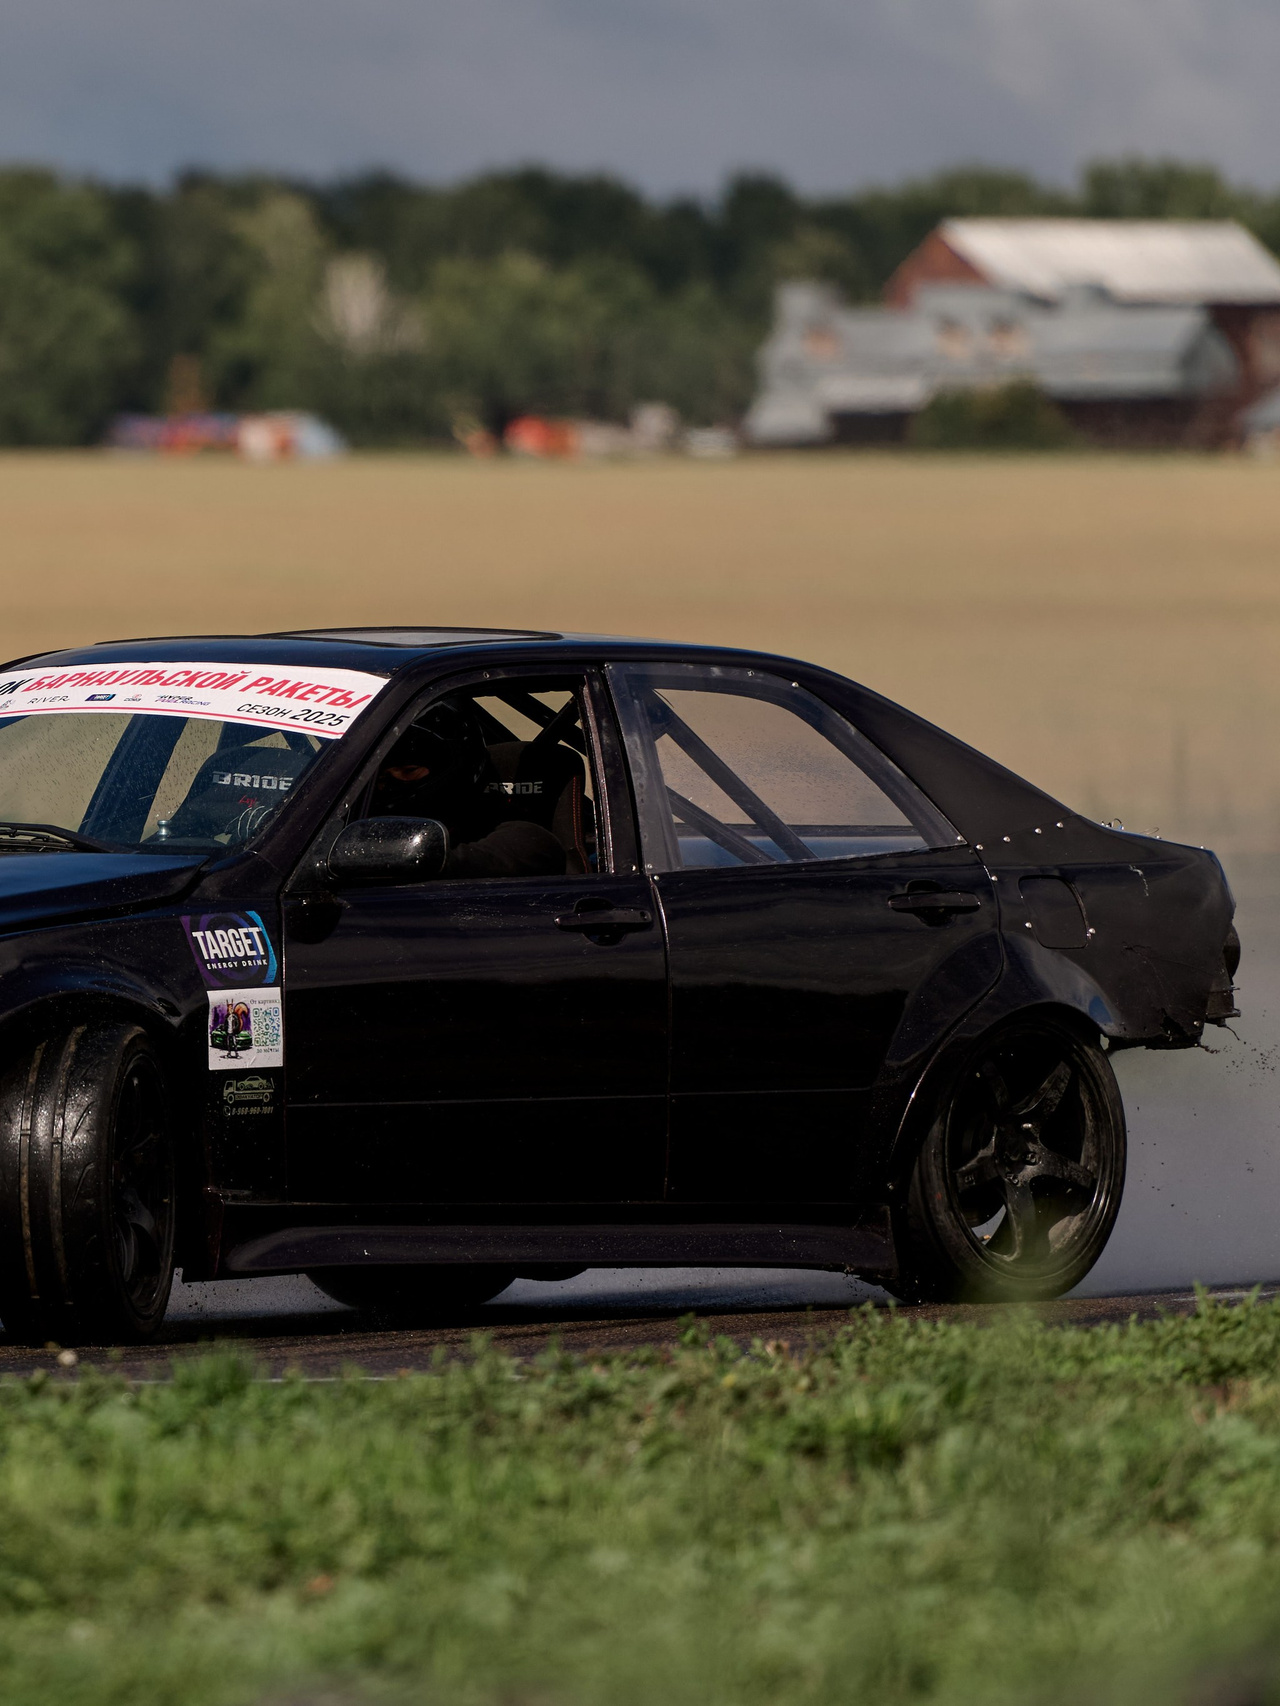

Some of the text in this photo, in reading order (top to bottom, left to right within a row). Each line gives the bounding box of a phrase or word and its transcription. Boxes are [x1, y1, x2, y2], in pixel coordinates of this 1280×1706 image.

[21, 670, 252, 693] БАРНАУЛЬСКОЙ
[239, 676, 372, 709] РАКЕТЫ
[27, 695, 70, 705] RIVER
[237, 703, 350, 727] СЕЗОН 2025
[212, 771, 294, 791] BRIDE
[192, 927, 265, 960] TARGET
[207, 959, 268, 970] ENERGY DRINK
